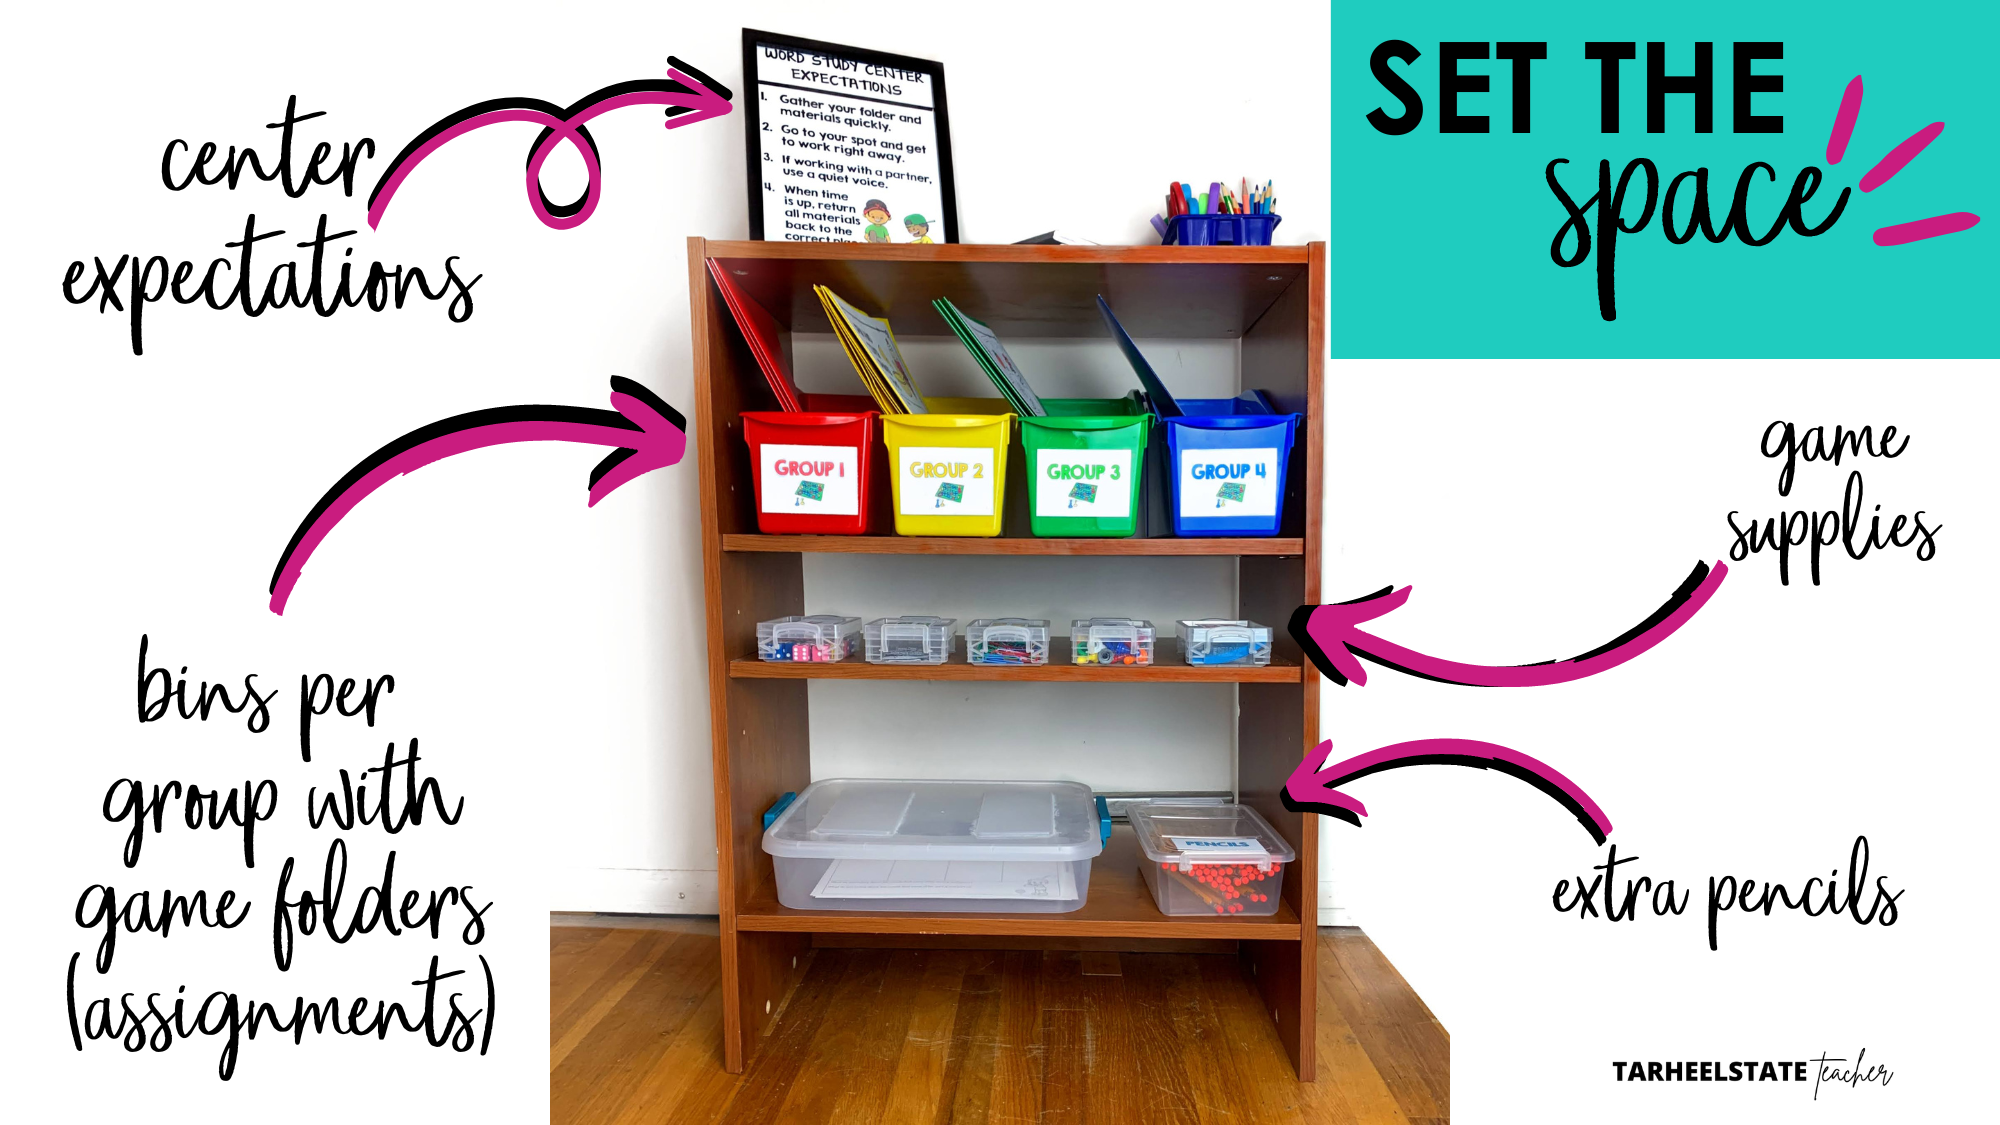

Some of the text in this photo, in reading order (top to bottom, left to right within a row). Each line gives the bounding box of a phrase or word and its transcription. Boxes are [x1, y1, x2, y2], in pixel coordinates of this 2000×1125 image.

[765, 47, 924, 84] WORD STUDY CENTER
[791, 68, 902, 96] EXPECTATIONS
[780, 94, 824, 109] Gather
[828, 104, 856, 114] your
[860, 106, 896, 120] folder
[899, 114, 922, 124] and
[780, 108, 892, 132] materials quickly.
[762, 122, 926, 154] 2. Go to your spot and get
[782, 136, 906, 164] to work right away.
[763, 152, 774, 162] 3.
[782, 155, 790, 164] If
[794, 158, 844, 173] working
[846, 165, 872, 176] with
[886, 171, 932, 184] partner,
[783, 168, 804, 177] use
[818, 173, 848, 183] quiet
[852, 178, 888, 188] voice.
[764, 182, 848, 201] 4. When time
[784, 196, 856, 214] is up, return
[784, 209, 860, 226] all materials
[786, 220, 852, 236] back to the
[774, 459, 844, 477] GROUP 1
[910, 461, 984, 479] GROUP 2
[1047, 463, 1121, 480] GROUP 3
[1191, 462, 1267, 480] GROUP 4
